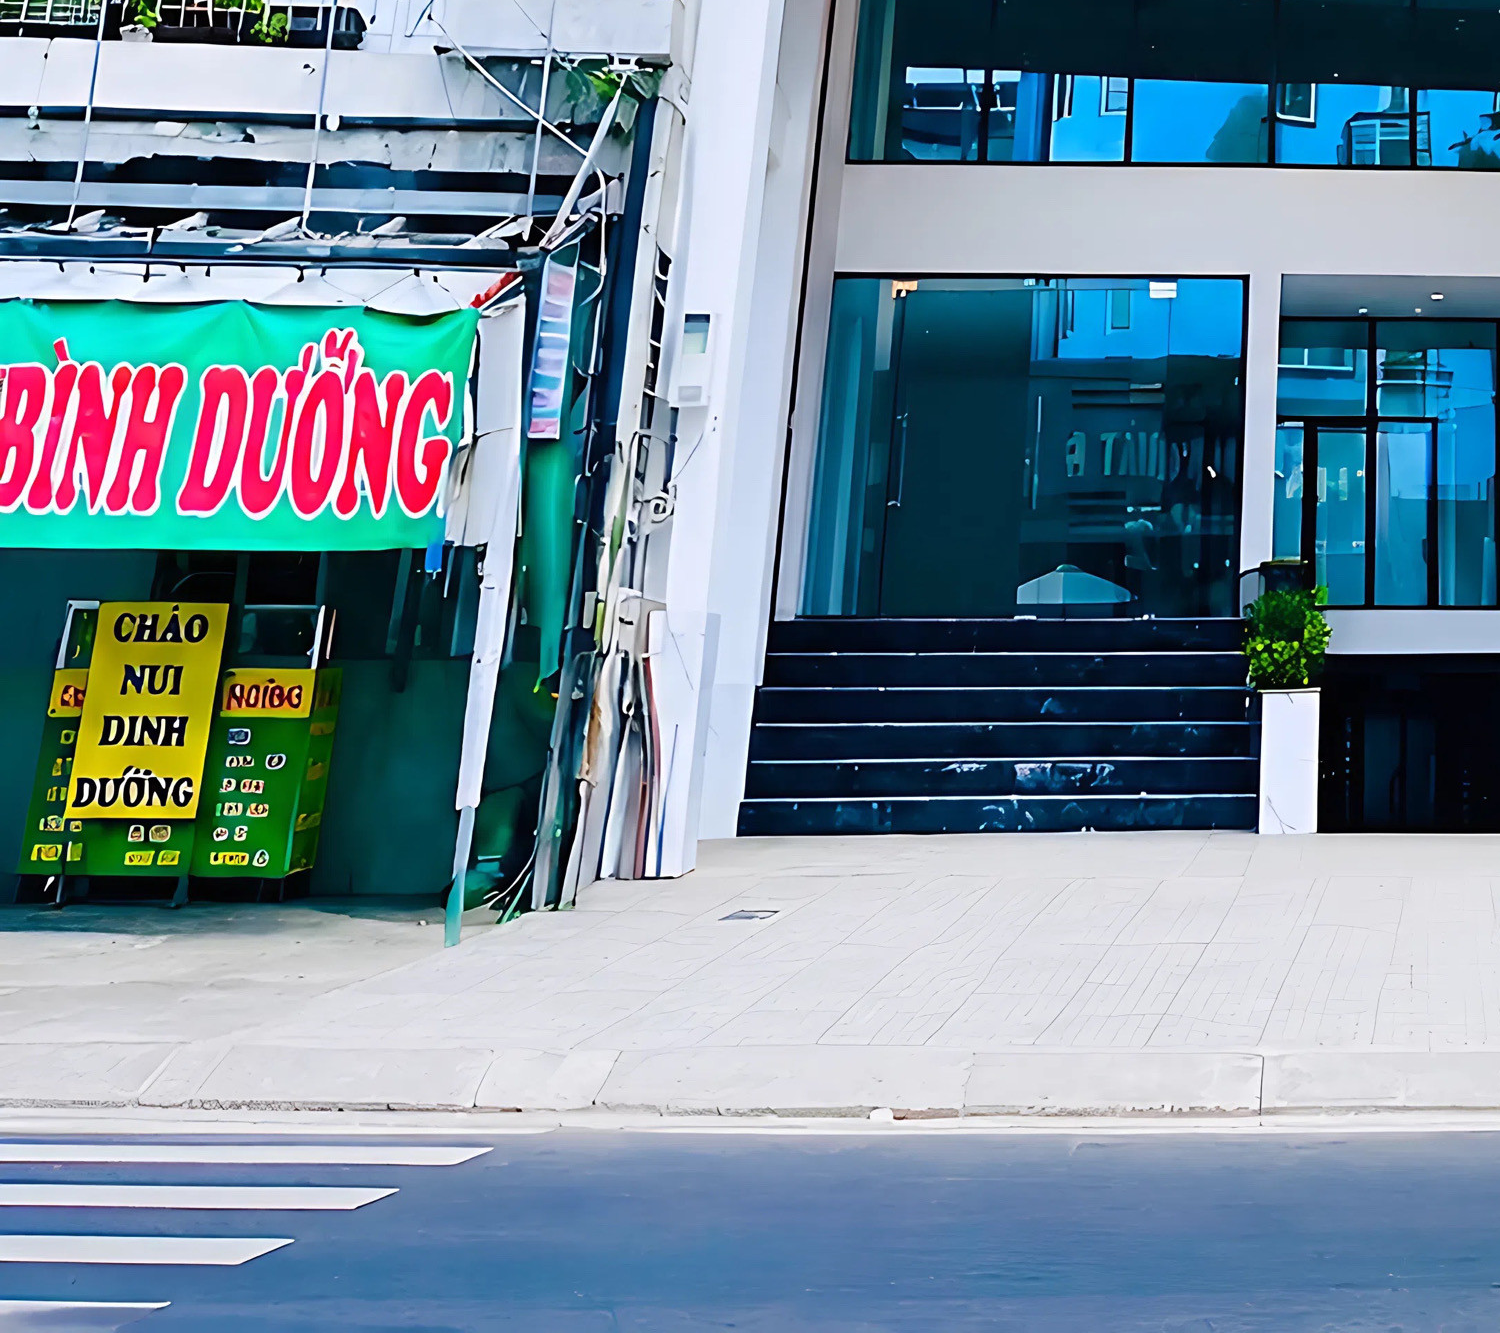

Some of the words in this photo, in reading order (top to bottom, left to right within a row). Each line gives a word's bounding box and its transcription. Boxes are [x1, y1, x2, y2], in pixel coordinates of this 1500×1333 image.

[176, 327, 453, 521] DƯỠNG
[120, 664, 184, 695] NUI
[98, 715, 189, 747] DINH
[71, 765, 194, 808] DƯỠNG
